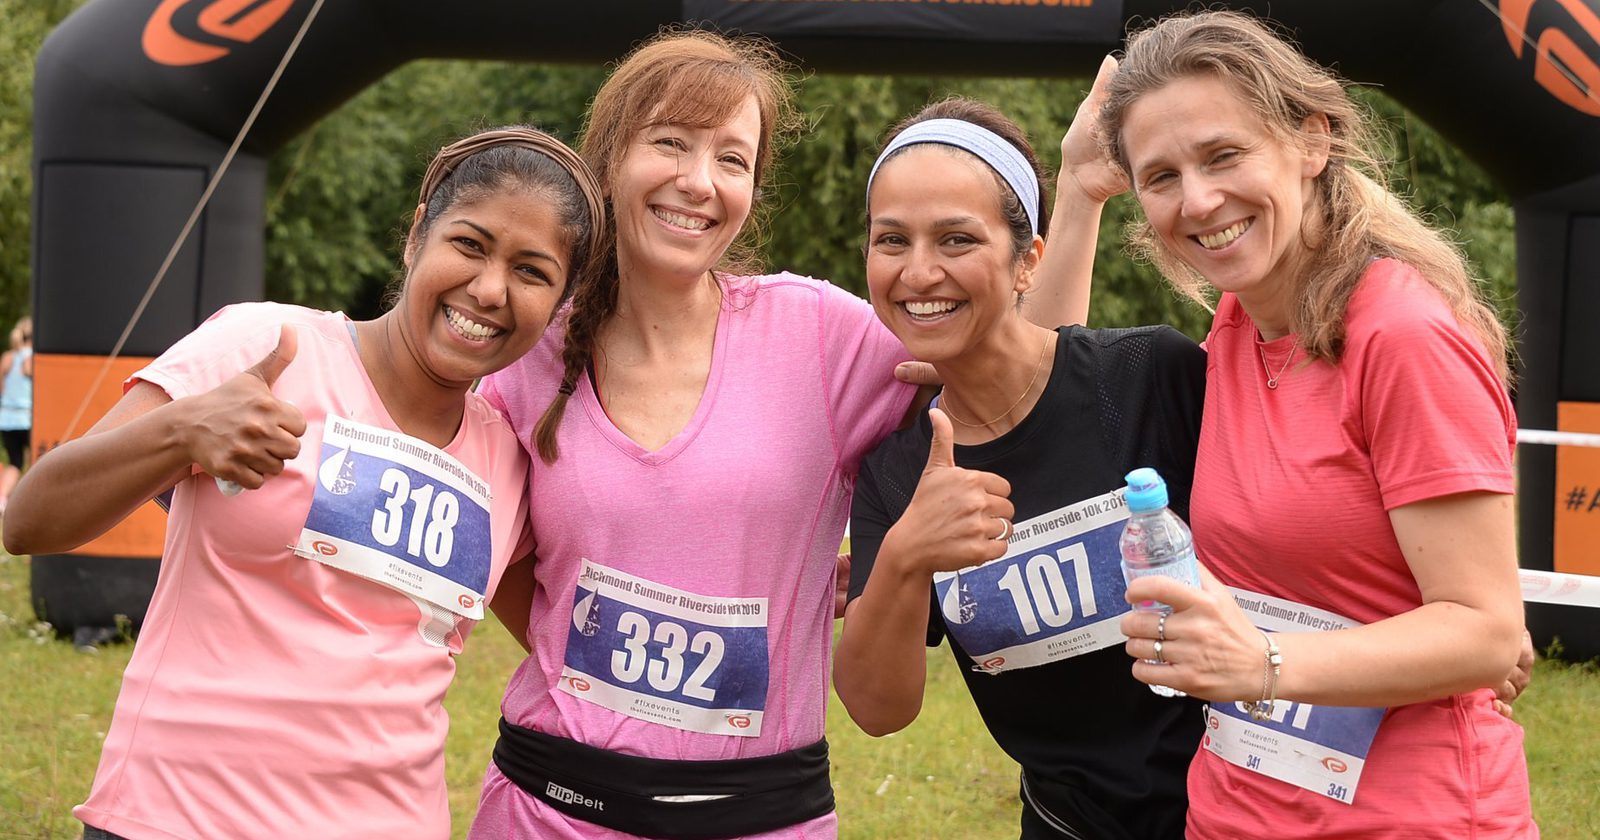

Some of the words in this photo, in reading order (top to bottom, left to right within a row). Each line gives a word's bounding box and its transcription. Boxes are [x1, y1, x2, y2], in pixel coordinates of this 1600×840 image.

[333, 421, 390, 447] Richmond
[392, 437, 432, 462] Summer
[433, 453, 465, 481] Riverside
[473, 481, 487, 497] 2019
[371, 467, 460, 568] 318
[1032, 511, 1081, 536] Riverside
[1082, 504, 1103, 519] 10k
[586, 565, 633, 592] Richmond
[634, 583, 678, 605] Summer
[679, 595, 727, 615] Riverside
[997, 541, 1098, 636] 107
[1234, 594, 1261, 613] hmond
[1261, 602, 1297, 623] Summer
[1047, 632, 1092, 650] #fixevents
[611, 611, 725, 702] 332
[634, 699, 680, 715] #fixevents
[1243, 729, 1279, 746] #fixevents
[1246, 754, 1261, 770] 341
[1327, 782, 1348, 801] 341
